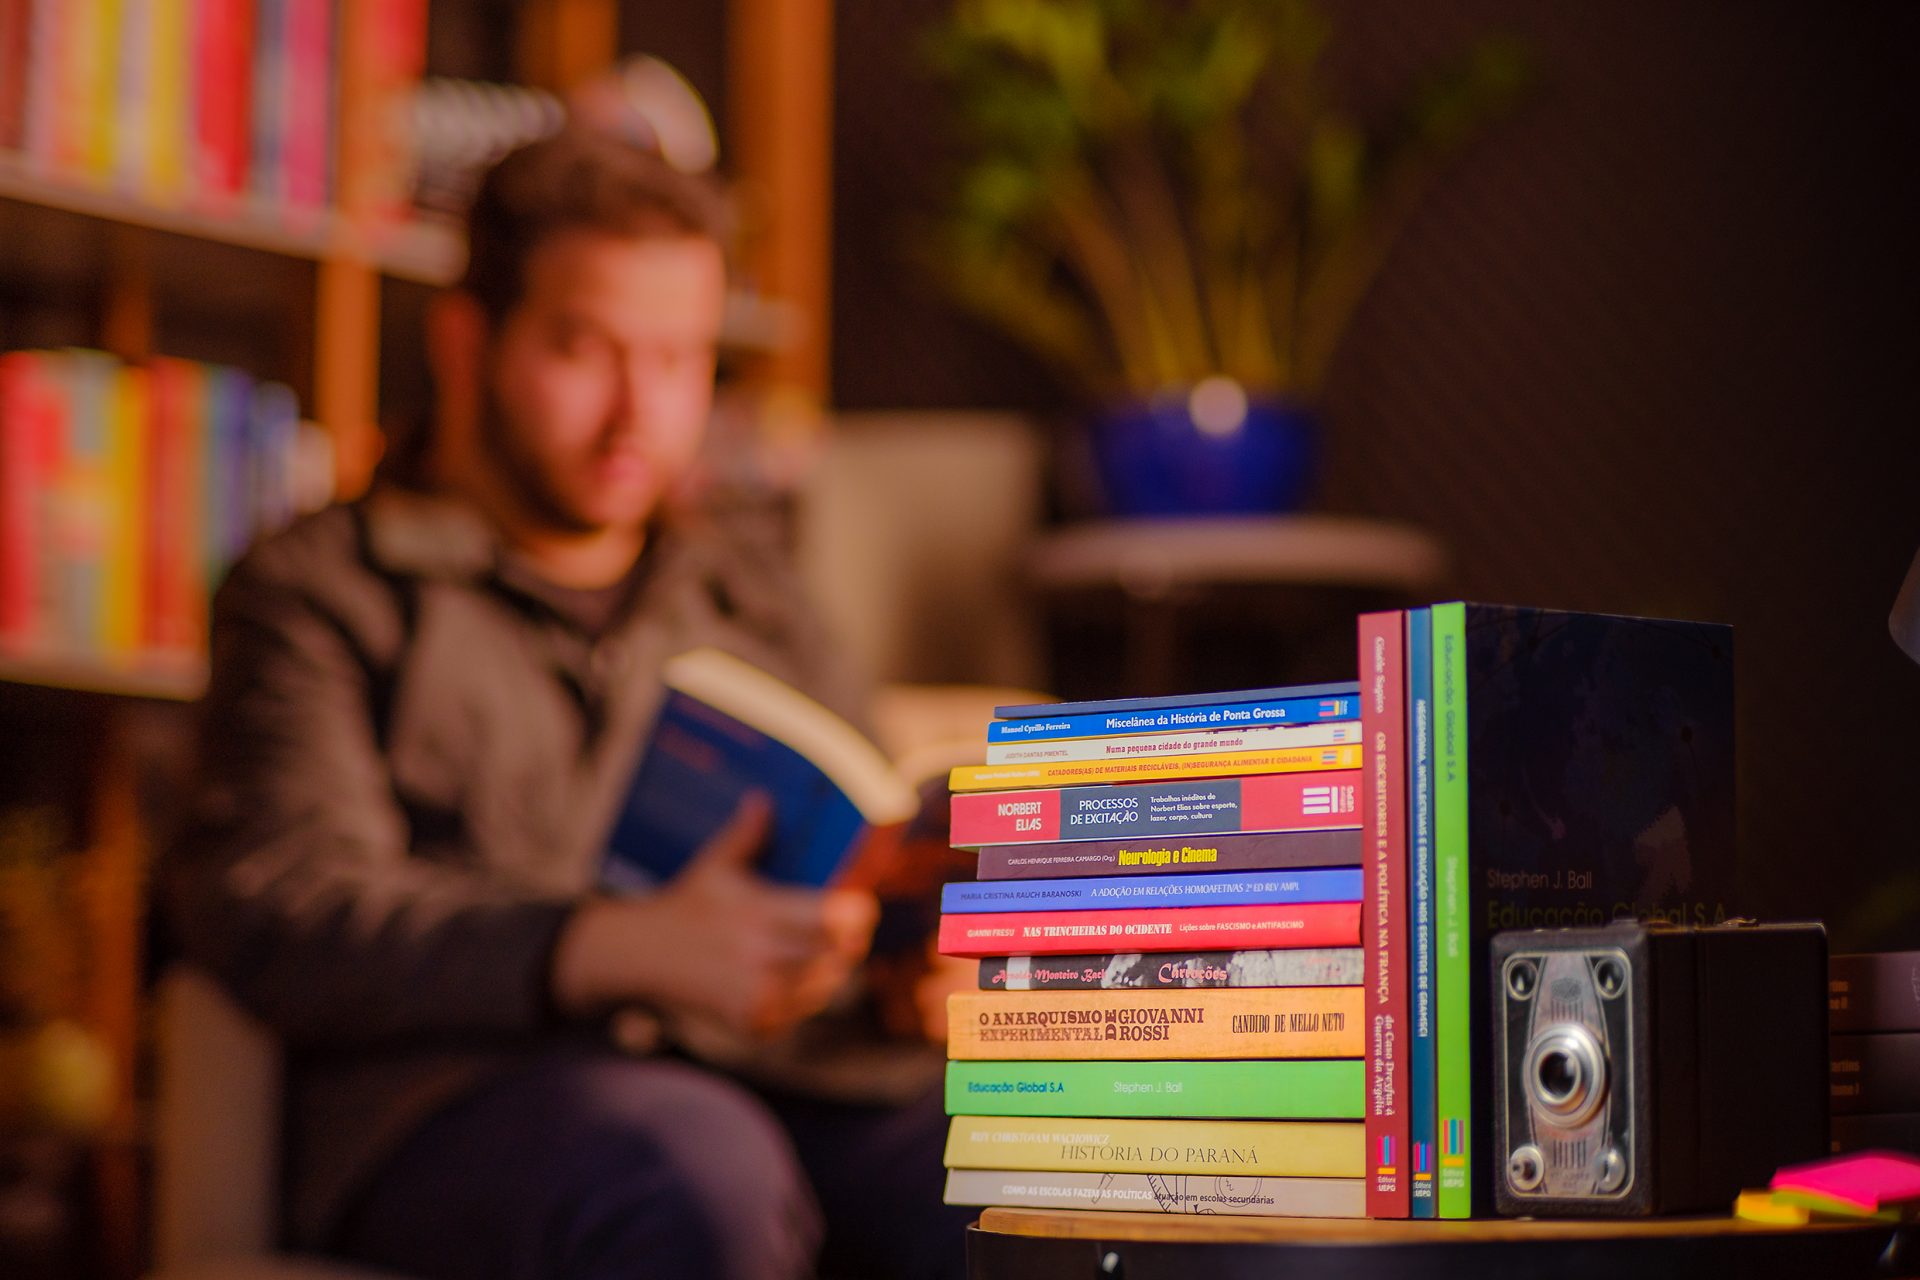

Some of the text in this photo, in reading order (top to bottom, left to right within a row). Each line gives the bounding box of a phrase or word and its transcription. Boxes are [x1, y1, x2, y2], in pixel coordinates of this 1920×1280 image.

[1444, 634, 1456, 706] Educação
[1106, 708, 1286, 728] Miscelânea da História de Ponta Grossa
[1045, 722, 1071, 731] Ferreira
[1446, 710, 1457, 756] Global
[1106, 738, 1243, 754] Numa pequena cidade do grande mundo
[1047, 767, 1093, 777] CATADORES(AS)
[1095, 767, 1103, 775] DE
[1104, 765, 1137, 774] MATERIAIS
[1233, 758, 1269, 767] ALIMENTAR
[1276, 755, 1313, 764] CIDADANIA
[1079, 797, 1139, 811] PROCESSOS
[1150, 792, 1216, 803] Trabalhos inéditos de
[997, 802, 1042, 816] NORBERT
[1211, 802, 1238, 811] esporte,
[1016, 818, 1042, 832] ELIAS
[1070, 810, 1139, 825] DE EXCITAÇÃO
[1150, 812, 1213, 822] lazer, corpo, cultura
[1008, 858, 1028, 866] CARLOS
[1028, 857, 1053, 865] HENRIQUE
[1053, 856, 1075, 864] FERREIRA
[1075, 855, 1102, 863] CAMARGO
[1118, 847, 1217, 866] Neurologia e Cinema
[1376, 732, 1390, 1004] OS ESCRITORES E A POLÍTICA NA FRANÇA
[1417, 846, 1429, 900] EDUCAÇÃO
[1487, 869, 1592, 892] Stephen J. Ball
[960, 890, 1082, 901] MARIA CRISTINA RAUCH BARANOSKI
[1091, 888, 1097, 897] A
[1098, 886, 1131, 898] ADOÇÃO
[1133, 887, 1144, 896] EM
[1145, 885, 1183, 897] RELAÇÕES
[1184, 883, 1243, 895] HOMOAFETIVAS
[1253, 883, 1264, 892] ED
[1265, 882, 1279, 892] REV
[1418, 901, 1428, 923] NOS
[1487, 898, 1605, 929] Educação
[992, 928, 1015, 937] FRESU
[1023, 923, 1173, 937] NAS TRINCHEIRAS DO OCIDENTE
[1179, 924, 1198, 933] Lições
[1198, 923, 1216, 931] sobre
[1216, 922, 1251, 930] FASCISMO
[1418, 925, 1428, 974] ESCRITOS
[1034, 969, 1079, 984] Monteiro
[1418, 975, 1428, 990] DE
[979, 1010, 1102, 1028] O ANARQUISMO
[1118, 1008, 1204, 1024] GIOVANNI
[1232, 1012, 1345, 1033] CANDIDO DE MELLO NETO
[1385, 1015, 1395, 1029] do
[1418, 991, 1428, 1038] GRAMSCI
[1105, 1009, 1117, 1041] DE
[1119, 1025, 1170, 1041] ROSSI
[980, 1027, 1103, 1041] EXPERIMENTAL
[1385, 1031, 1394, 1060] Caso
[1373, 1015, 1384, 1116] Guerra da Argélia
[968, 1081, 1065, 1095] Educação Global S.A
[1113, 1081, 1153, 1095] Stephen
[1166, 1081, 1183, 1094] Ball
[1383, 1061, 1395, 1106] Dreyfus
[1060, 1144, 1258, 1164] HISTÓRIA DO PARANÁ
[1002, 1185, 1152, 1200] COMO AS ESCOLAS FAZEM AS POLÍTICAS
[1199, 1193, 1227, 1202] escolas
[1228, 1194, 1275, 1204] secundárias
